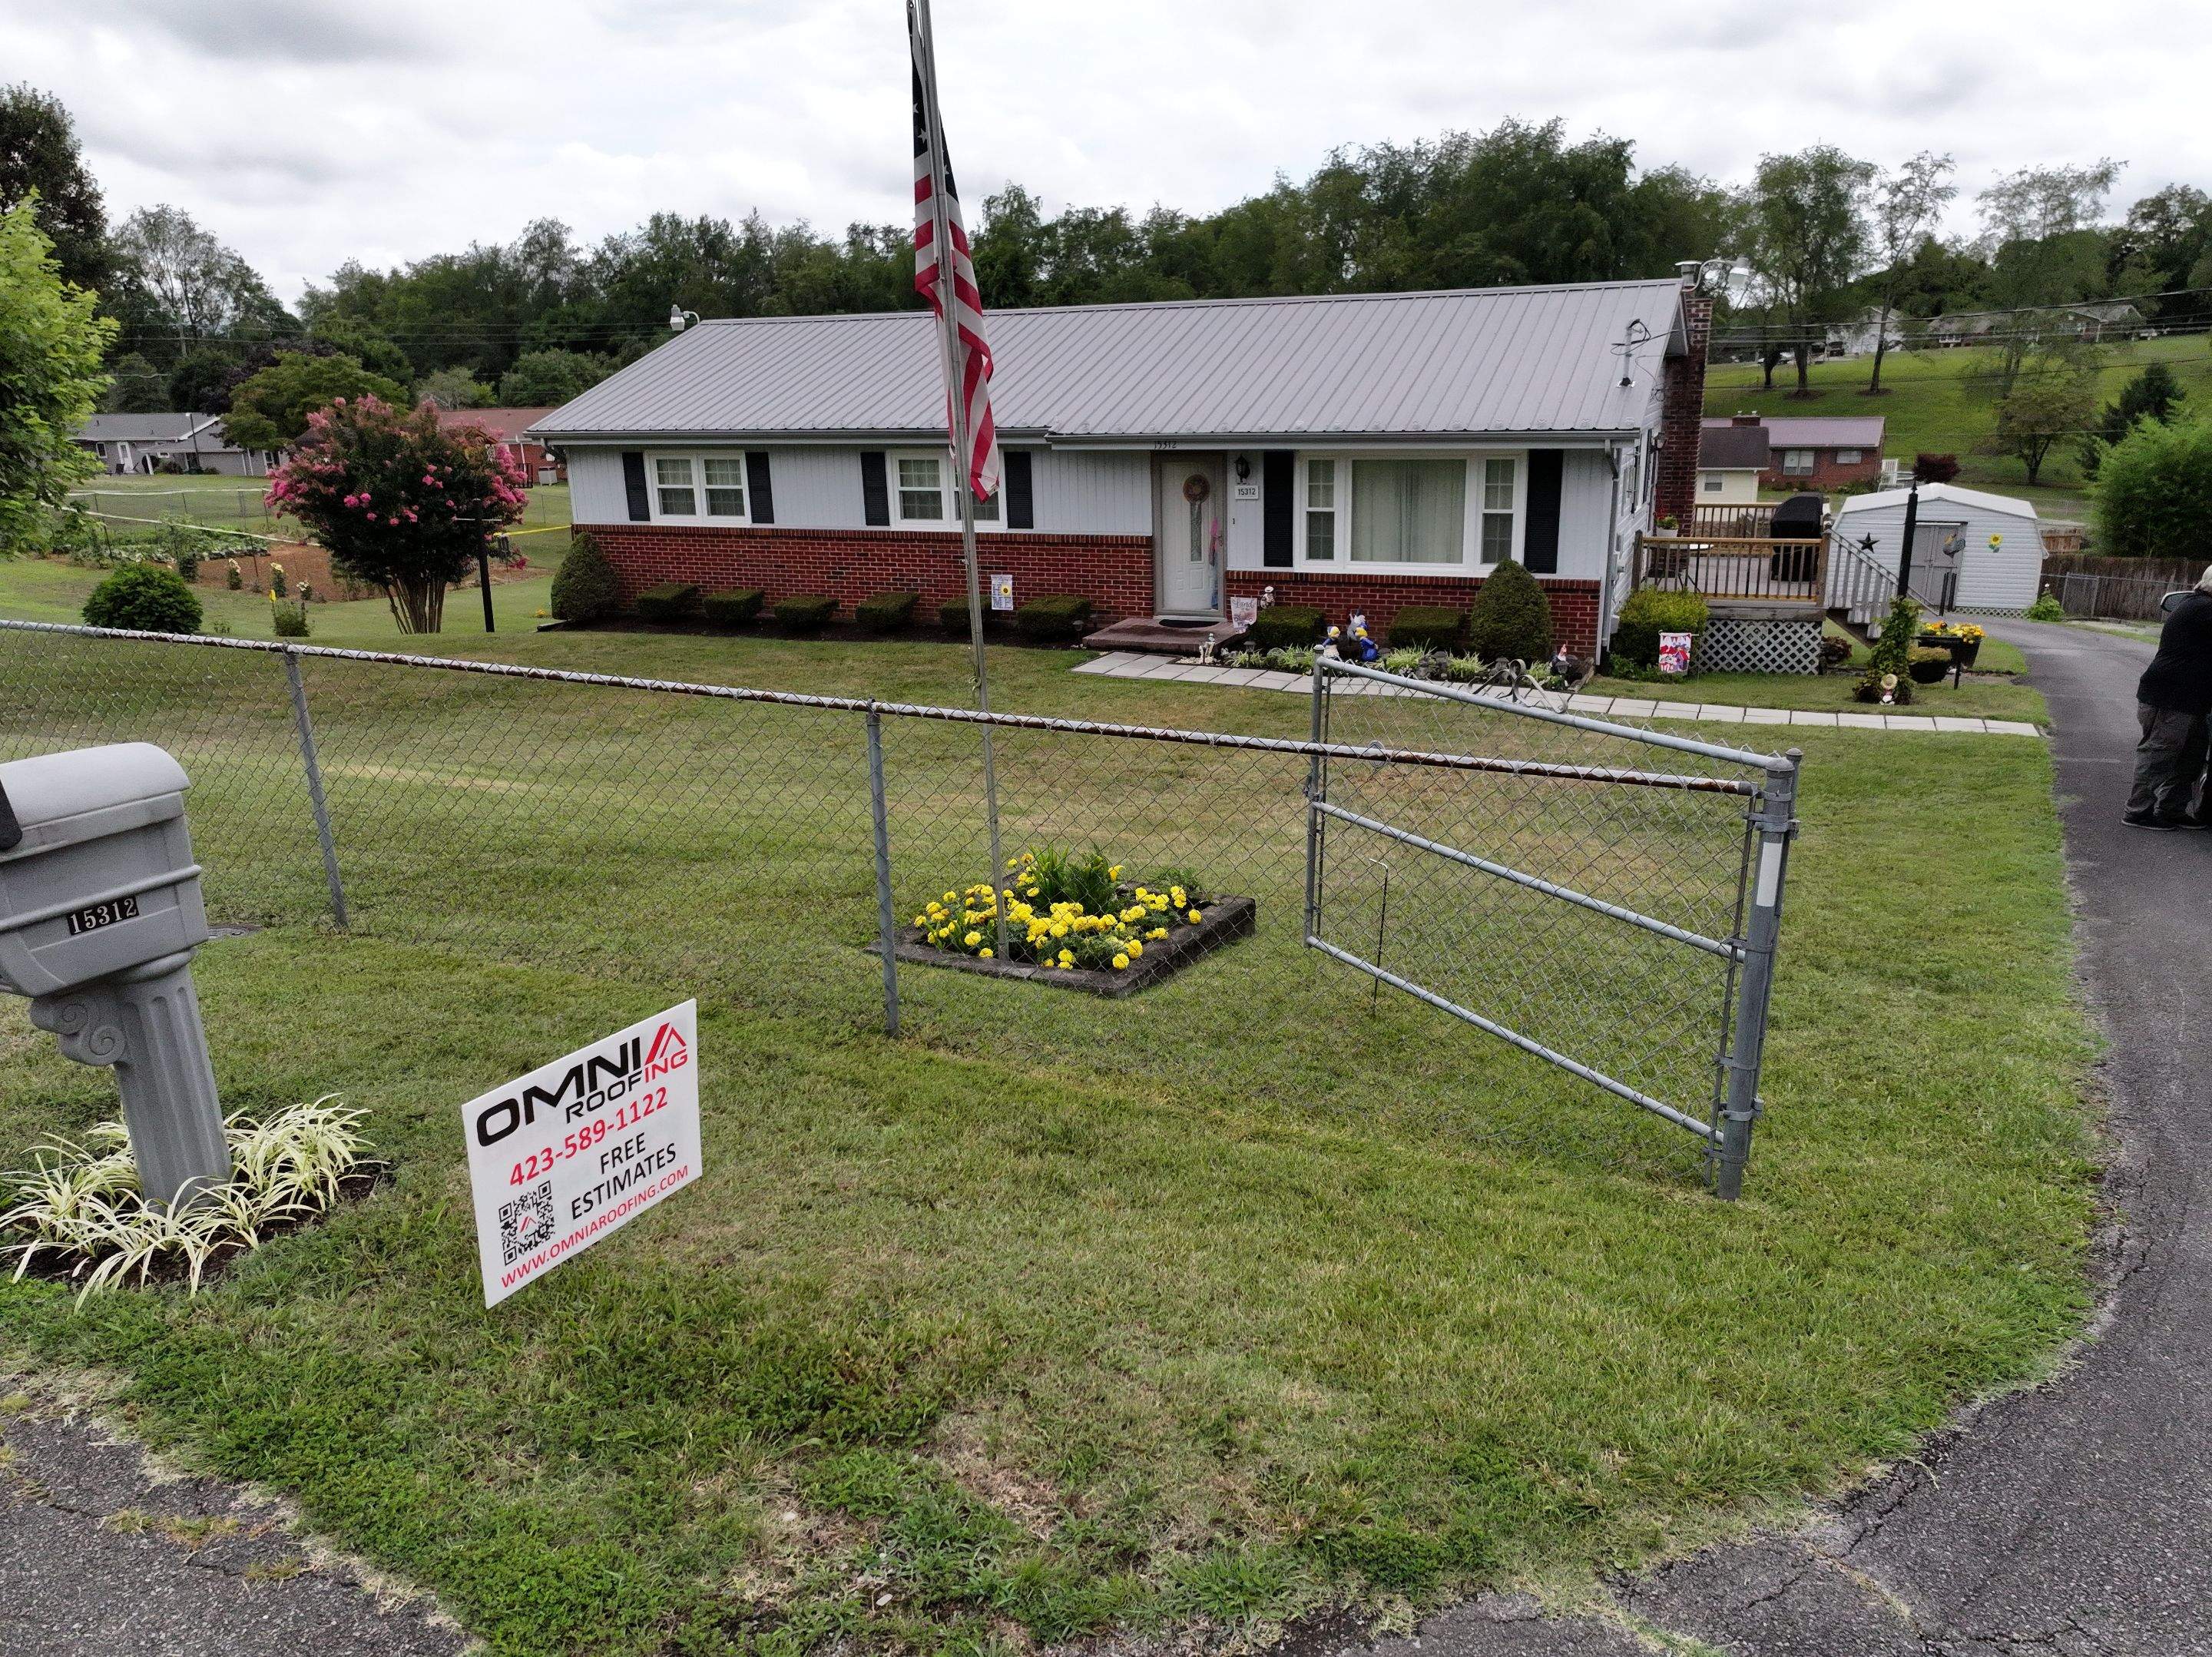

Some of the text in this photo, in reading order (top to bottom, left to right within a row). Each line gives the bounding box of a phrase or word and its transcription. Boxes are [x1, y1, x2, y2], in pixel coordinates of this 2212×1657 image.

[70, 898, 137, 934] 15312
[565, 1049, 688, 1123] ROOFING
[511, 1087, 667, 1187] 423-589-1122
[600, 1132, 646, 1174] FREE
[572, 1143, 677, 1220] ESTIMATES
[502, 1166, 688, 1287] WWW.OMNIAROOFING.COM
